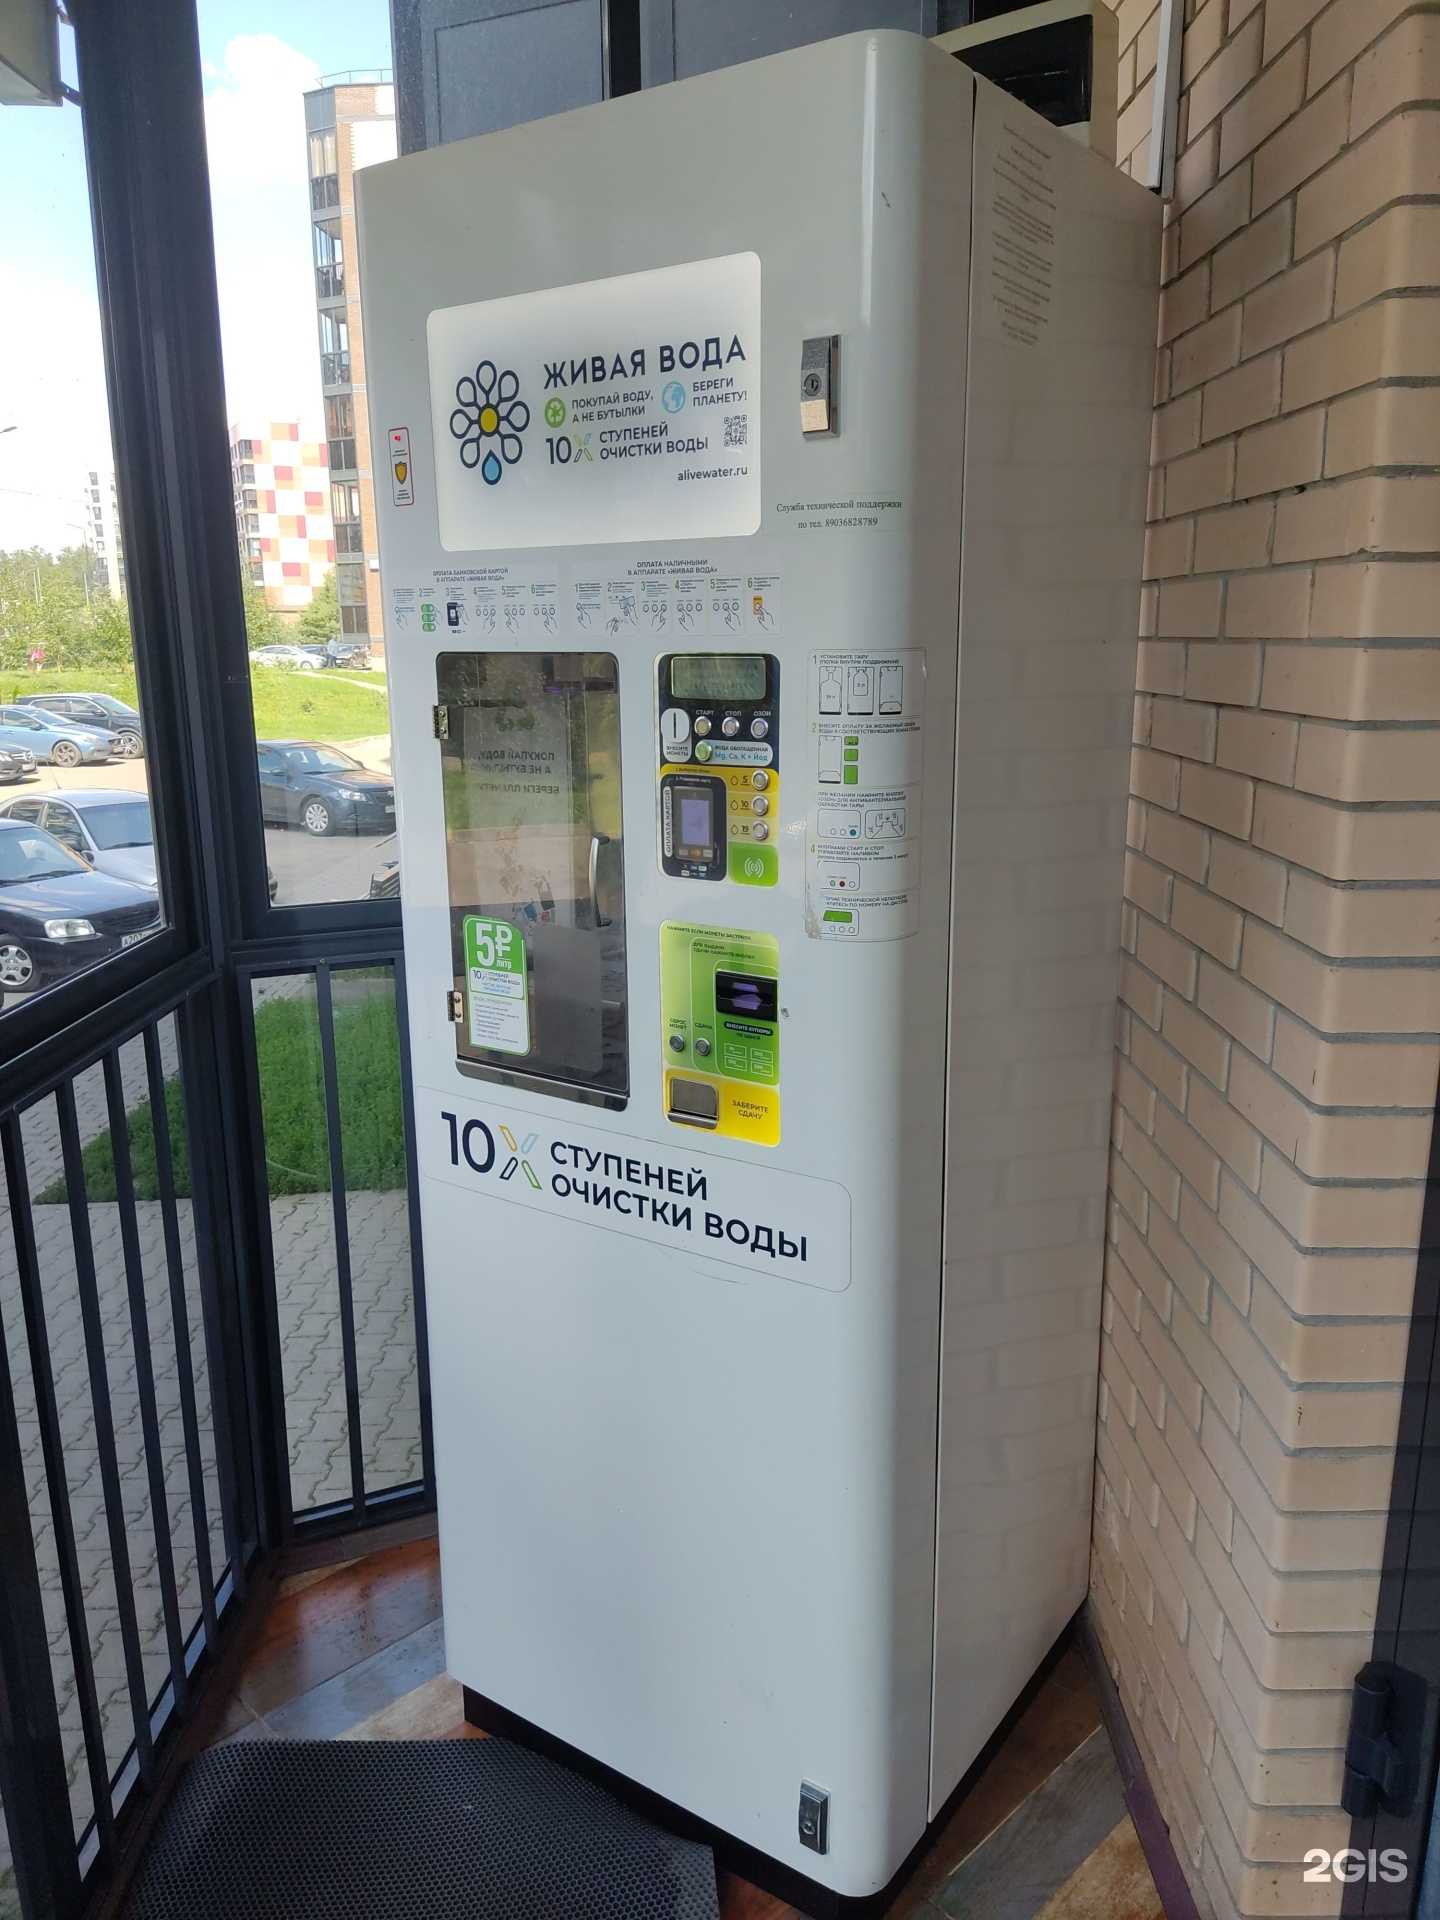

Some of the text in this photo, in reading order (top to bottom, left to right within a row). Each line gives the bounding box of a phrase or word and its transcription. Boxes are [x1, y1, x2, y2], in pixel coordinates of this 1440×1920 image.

[544, 334, 746, 390] ЖИВАЯ ВОДА
[692, 377, 734, 392] БЕРЕГИ
[572, 389, 654, 409] ПОКУПАЙ ВОДУ,
[693, 390, 747, 407] ПЛАНЕТУ!
[572, 405, 645, 424] А НЕ БУТЫЛКИ
[600, 421, 668, 443] СТУПЕНЕЙ
[600, 437, 708, 460] ОЧИСТКИ ВОДЫ
[677, 466, 748, 481] alivewater.ru
[776, 503, 804, 513] Служба
[807, 500, 854, 511] технической
[665, 559, 708, 567] НАЛИЧНЫМИ
[731, 1099, 768, 1113] ЗАБЕРИТЕ
[738, 1109, 763, 1120] СДАЧУ
[550, 1141, 707, 1200] СТУПЕНЕЙ
[551, 1173, 808, 1261] ОЧИСТКИ ВОДЫ
